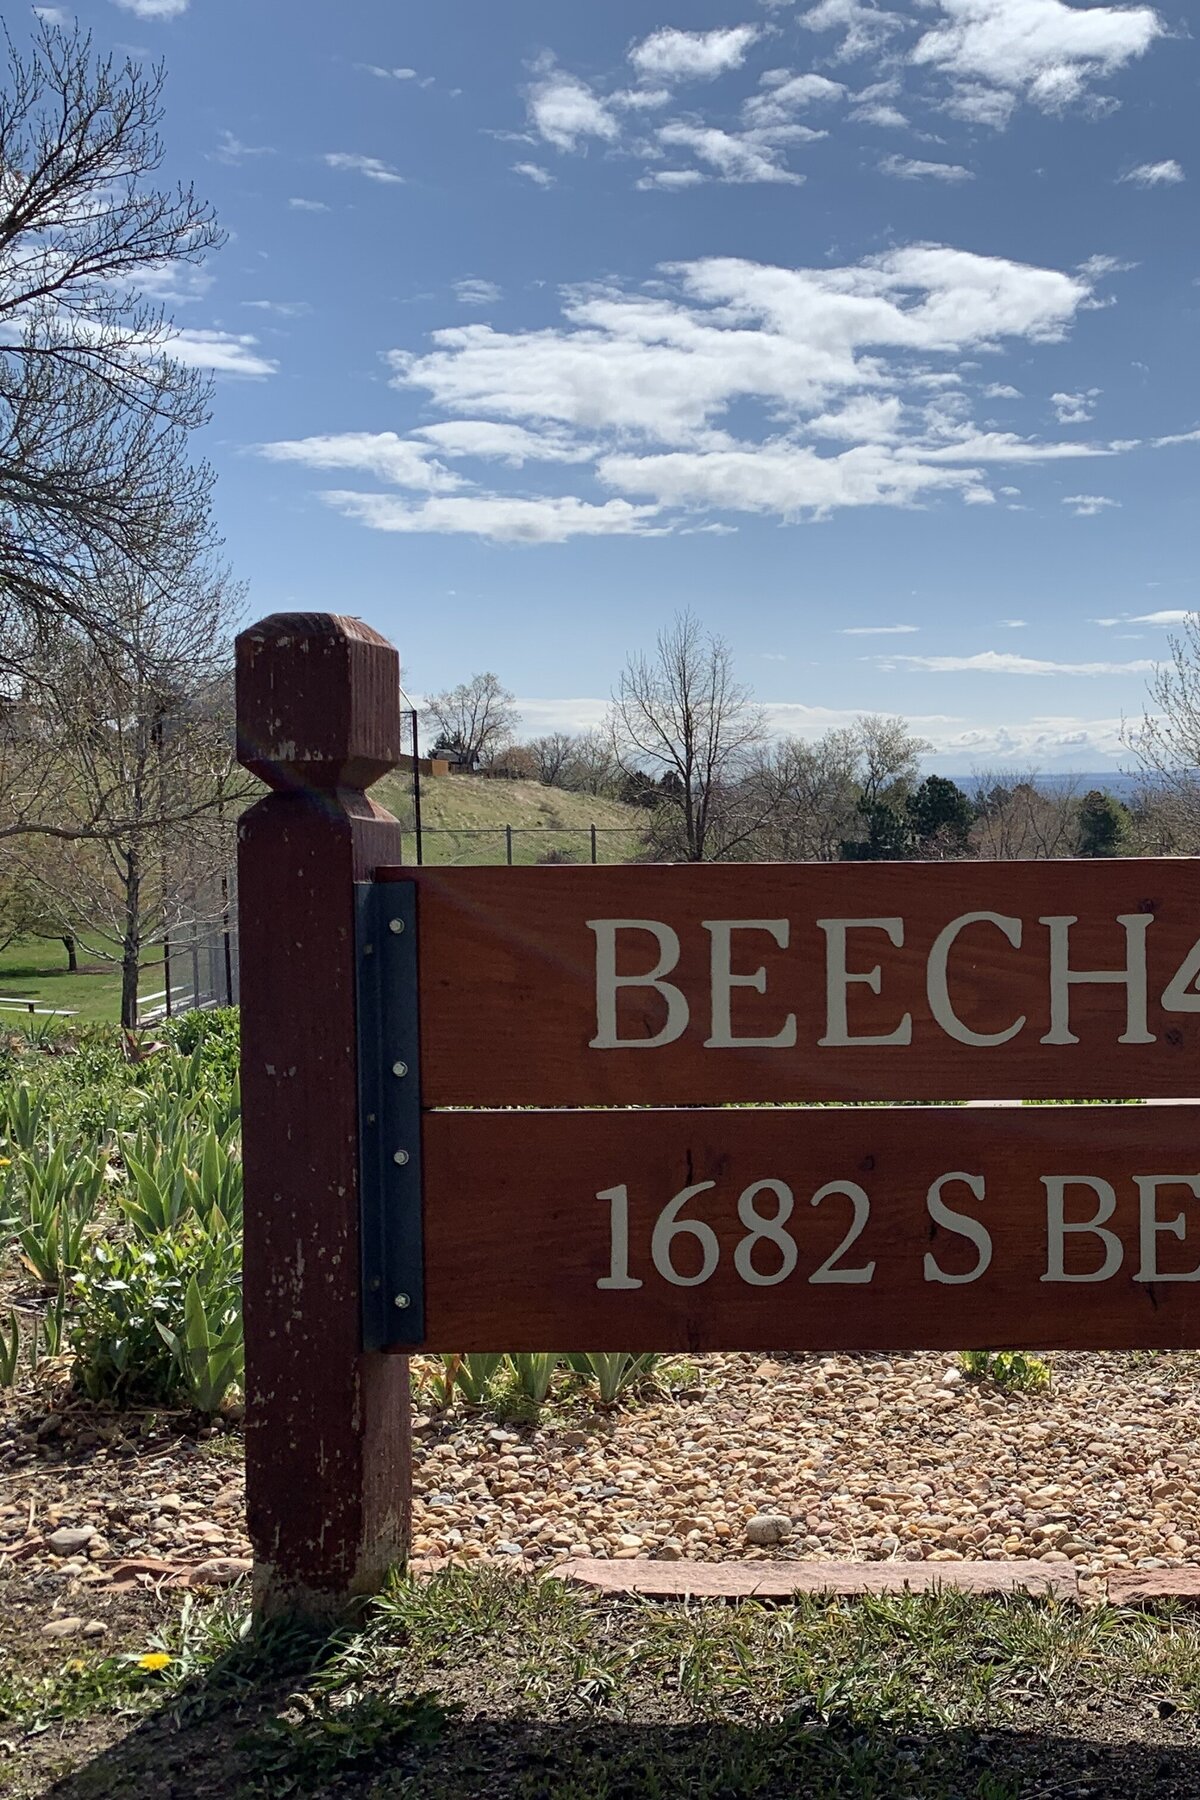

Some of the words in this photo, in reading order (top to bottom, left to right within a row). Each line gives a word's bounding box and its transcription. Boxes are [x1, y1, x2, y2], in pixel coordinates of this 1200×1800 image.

[585, 909, 1158, 1051] BEECH
[595, 1178, 876, 1291] 1682
[923, 1171, 994, 1286] S
